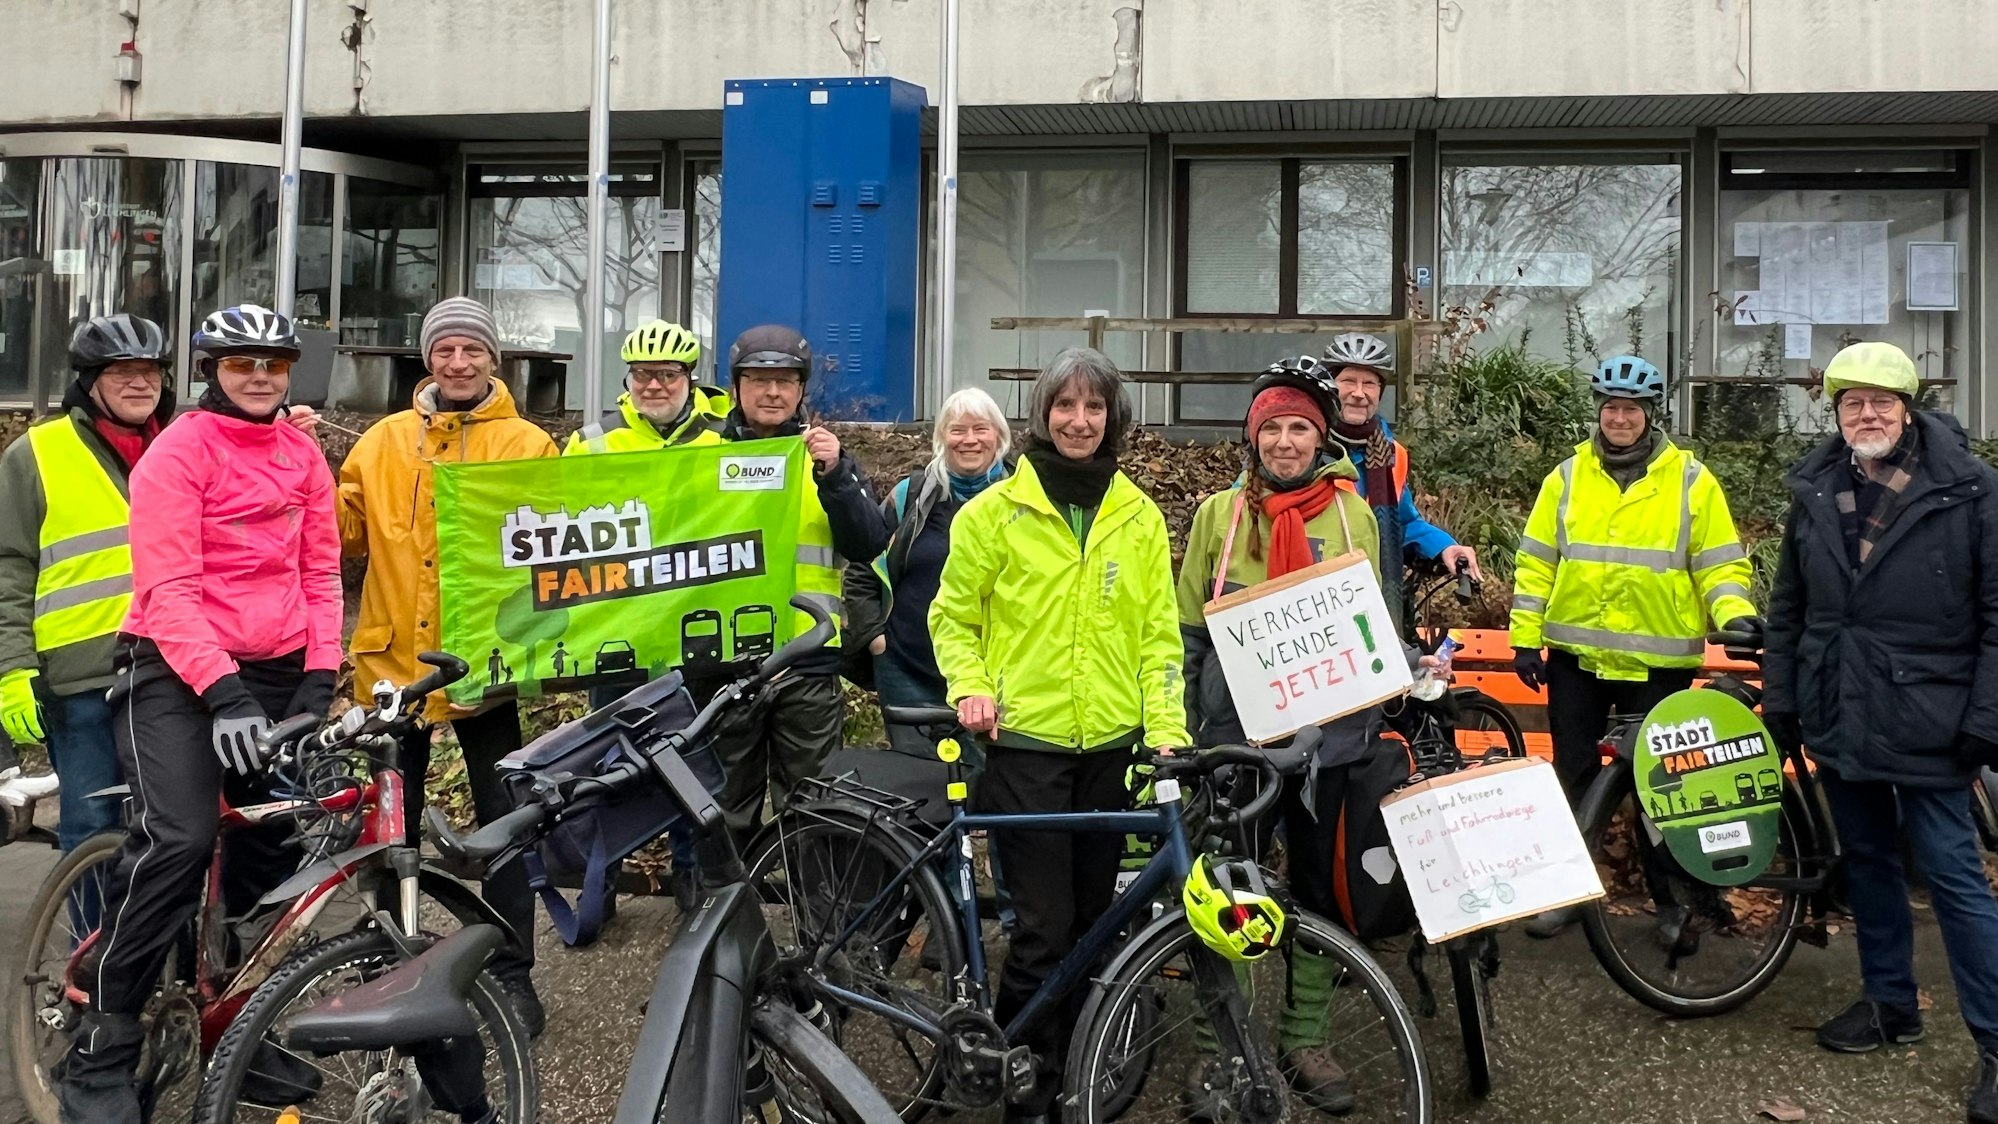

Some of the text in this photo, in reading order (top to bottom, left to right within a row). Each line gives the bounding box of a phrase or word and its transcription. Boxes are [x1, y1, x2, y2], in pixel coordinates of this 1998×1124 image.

[741, 467, 775, 477] BUND
[511, 517, 641, 561] STADT
[537, 540, 756, 602] FAIRTEILEN
[1227, 580, 1365, 647] VERKEHRS-
[1256, 624, 1338, 670] WENDE
[1269, 648, 1358, 711] JETZT
[1651, 726, 1709, 752] STADT
[1663, 736, 1765, 774] FAIRTEILEN
[1400, 787, 1504, 825] mehr und bessere
[1440, 820, 1460, 837] und
[1716, 830, 1740, 841] BUND
[1419, 858, 1436, 871] für
